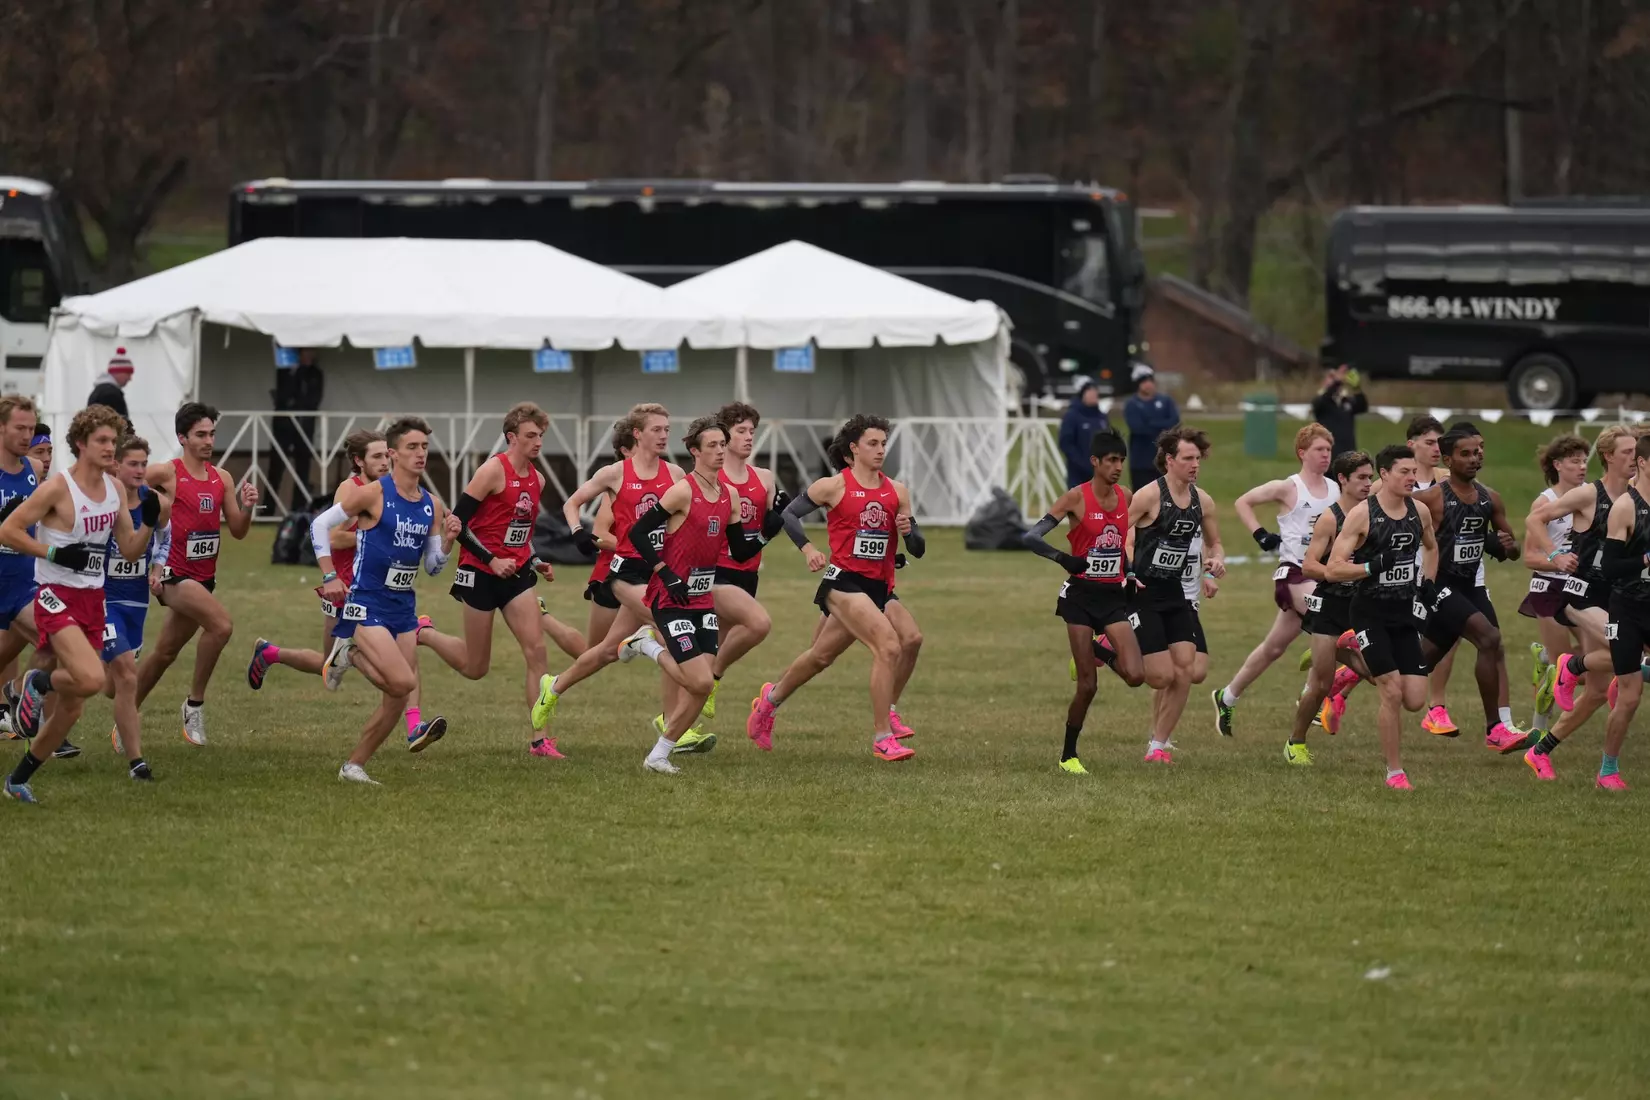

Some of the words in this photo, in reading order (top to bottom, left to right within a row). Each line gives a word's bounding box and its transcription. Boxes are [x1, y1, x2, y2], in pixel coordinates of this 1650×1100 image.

[83, 512, 118, 535] IUPU
[396, 514, 429, 536] Indiana
[1169, 520, 1195, 536] P
[1460, 517, 1484, 533] P
[393, 530, 424, 549] State
[510, 530, 528, 542] 591
[650, 533, 664, 546] 90
[1391, 533, 1414, 550] P
[192, 541, 214, 555] 464
[860, 541, 884, 554] 599
[1460, 546, 1480, 559] 603
[88, 556, 102, 570] 06
[1159, 552, 1182, 566] 607
[114, 561, 140, 574] 491
[1091, 560, 1117, 572] 597
[392, 573, 414, 585] 492
[1386, 567, 1410, 581] 605
[691, 578, 710, 591] 465
[40, 591, 60, 610] 506
[321, 602, 332, 614] 60
[345, 606, 361, 618] 492
[674, 621, 693, 632] 465
